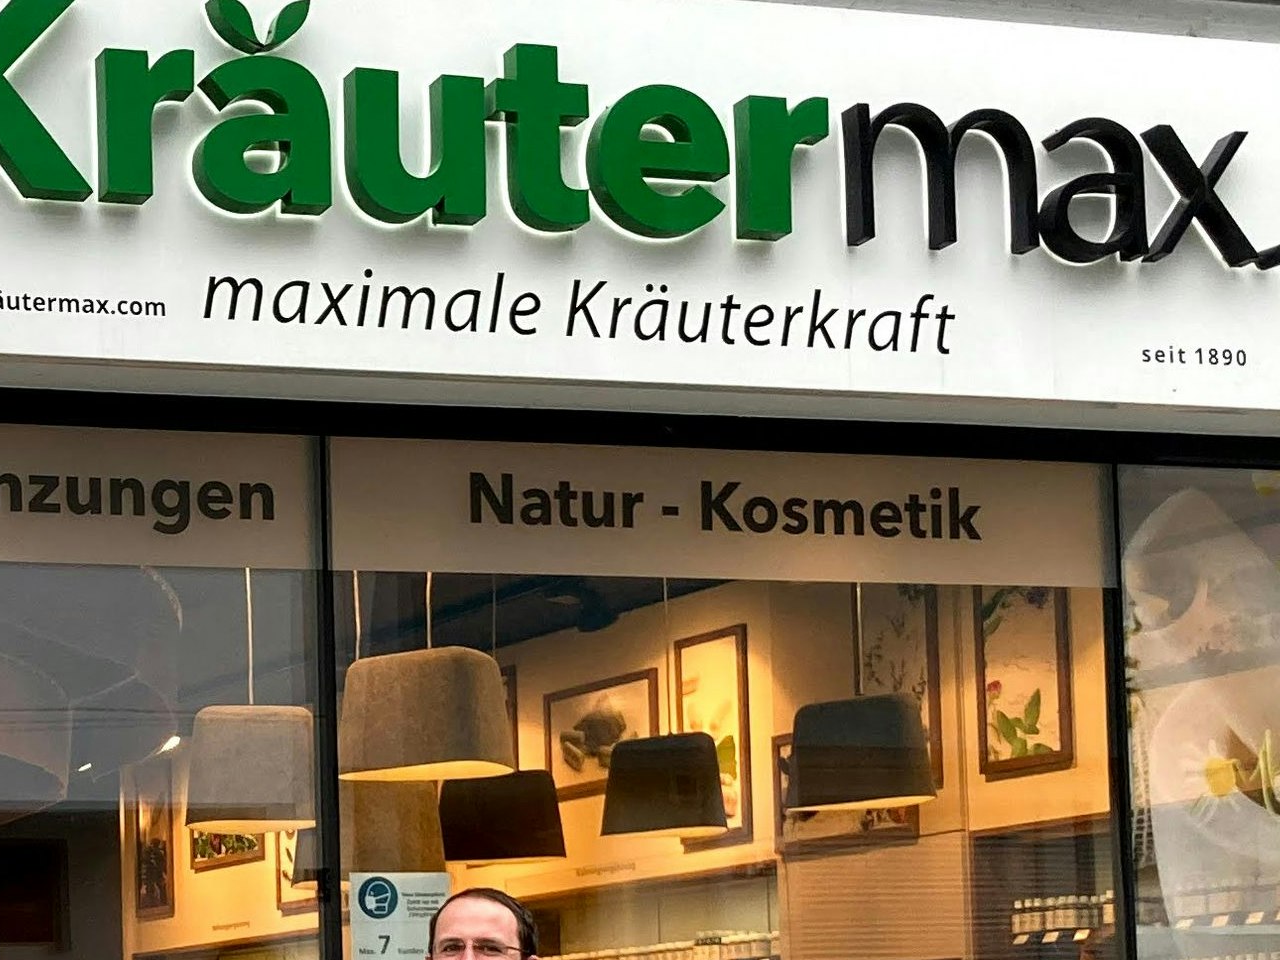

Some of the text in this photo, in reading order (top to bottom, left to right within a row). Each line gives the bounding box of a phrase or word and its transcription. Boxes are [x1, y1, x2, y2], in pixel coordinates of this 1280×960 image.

[203, 269, 957, 355] maximale Kräuterkraft
[1141, 345, 1248, 367] seit 1890
[468, 471, 644, 531] Natur
[700, 480, 982, 541] Kosmetik
[378, 935, 391, 955] 7
